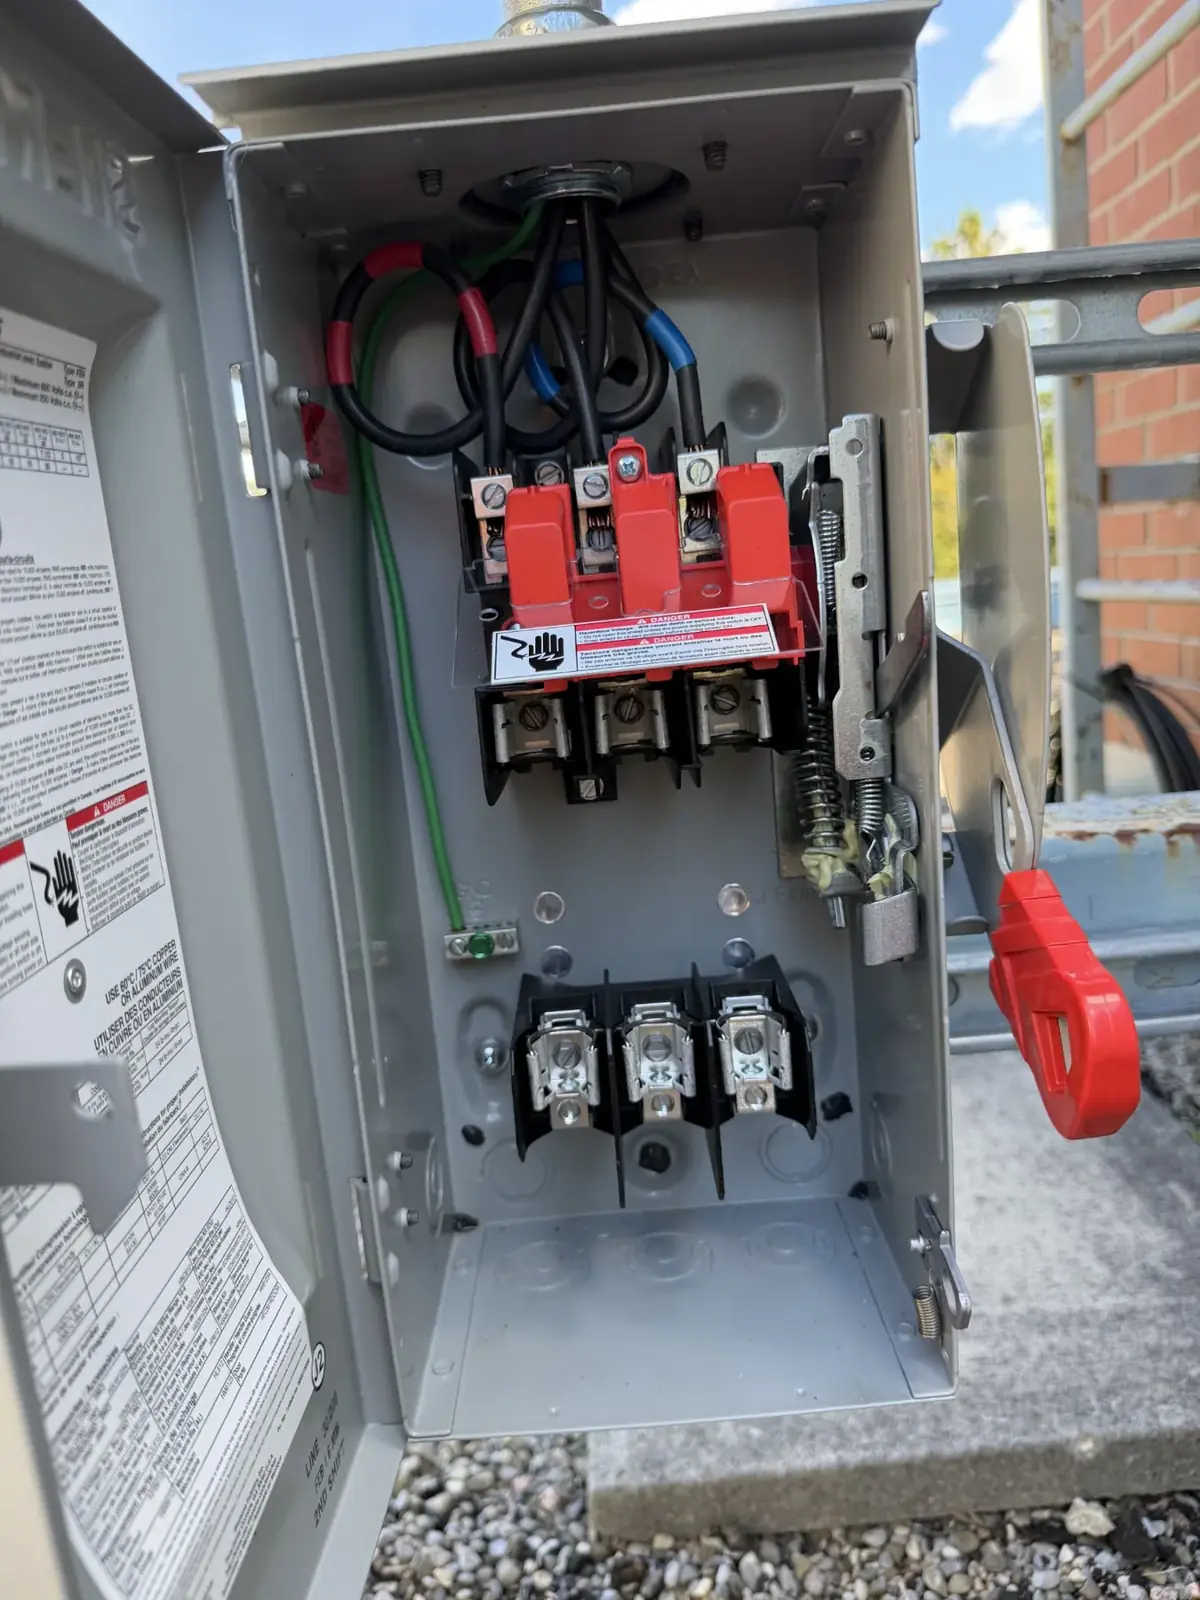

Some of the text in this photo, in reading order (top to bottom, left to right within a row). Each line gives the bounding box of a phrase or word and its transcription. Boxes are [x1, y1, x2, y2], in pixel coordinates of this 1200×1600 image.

[650, 613, 690, 623] DANGER
[653, 634, 694, 643] DANGER
[102, 793, 126, 812] DANGER
[105, 984, 120, 1004] USE
[152, 939, 176, 965] COPPER
[120, 950, 178, 1006] OR ALUMINUM WIRE
[94, 1016, 124, 1050] UTILISER
[124, 1004, 138, 1024] DES
[138, 966, 181, 1011] CONDUCTEURS
[108, 1023, 133, 1054] CUIVRE
[133, 1014, 142, 1030] OU
[143, 1004, 152, 1021] EN
[152, 978, 183, 1014] ALUMINIUM
[175, 1392, 198, 1430] rechange
[306, 1437, 320, 1478] LINE
[314, 1488, 327, 1528] 2ND
[328, 1437, 345, 1491] SHIFT
